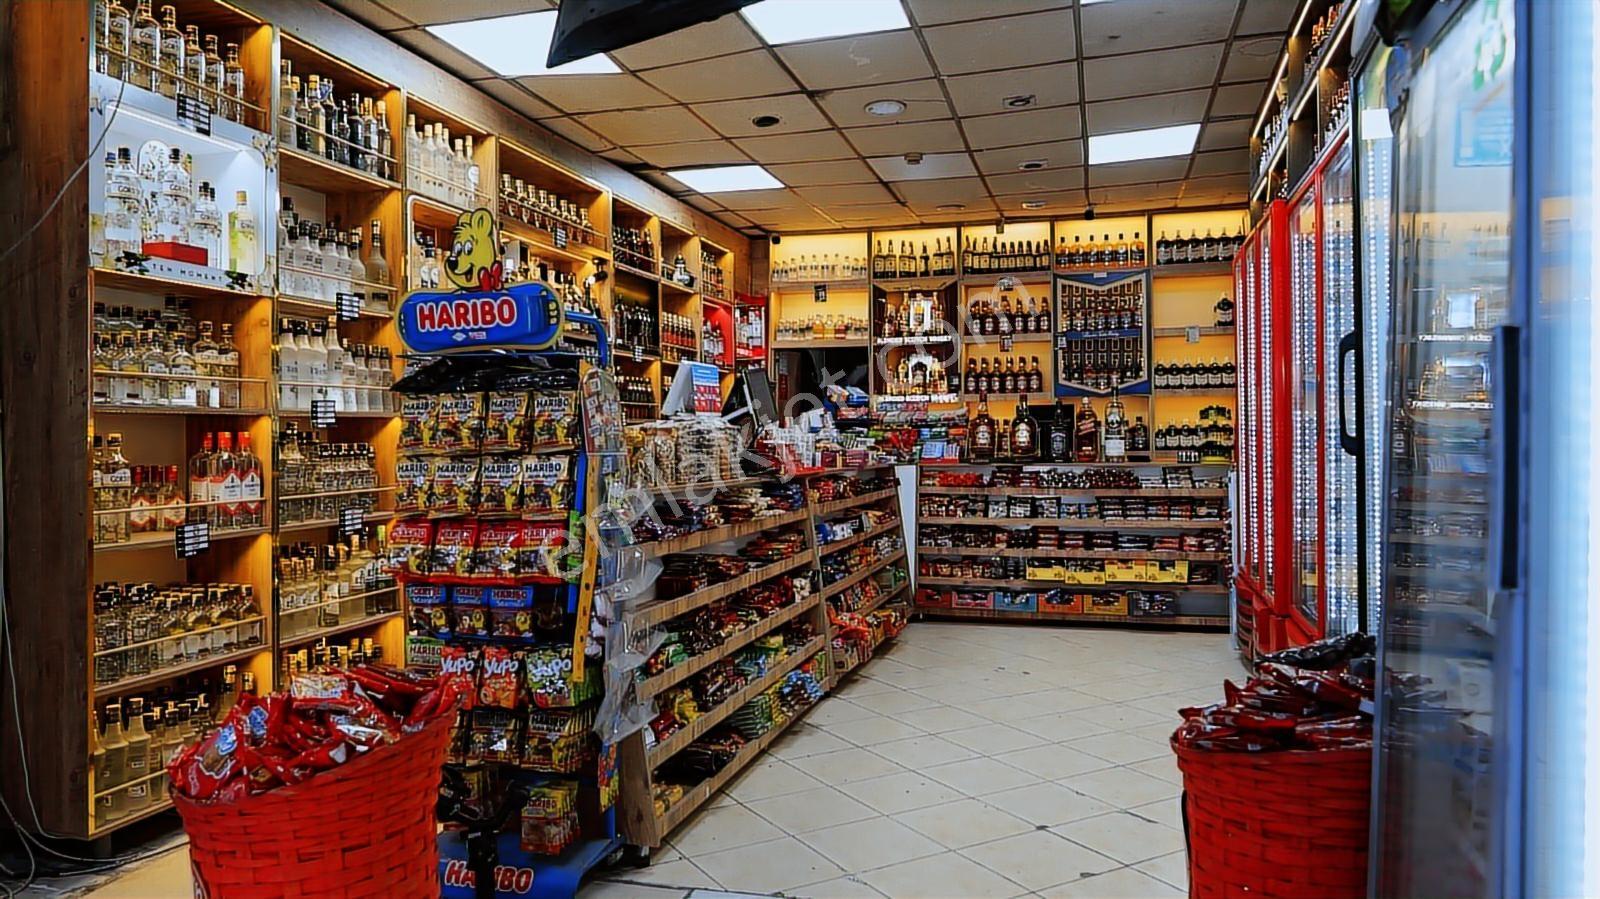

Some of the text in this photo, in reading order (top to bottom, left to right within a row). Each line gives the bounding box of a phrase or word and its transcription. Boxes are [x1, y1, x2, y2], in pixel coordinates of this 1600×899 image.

[417, 296, 517, 333] HARIBO
[403, 401, 436, 411] HARIBO
[441, 400, 475, 410] HARIBO
[536, 398, 569, 409] HARIBO
[397, 463, 429, 473] HARIBO
[437, 463, 473, 473] HARIBO
[483, 463, 518, 473] HARIBO
[525, 462, 562, 473] HARIBO
[491, 589, 529, 600] HARIBO
[408, 645, 441, 656] HARIBO
